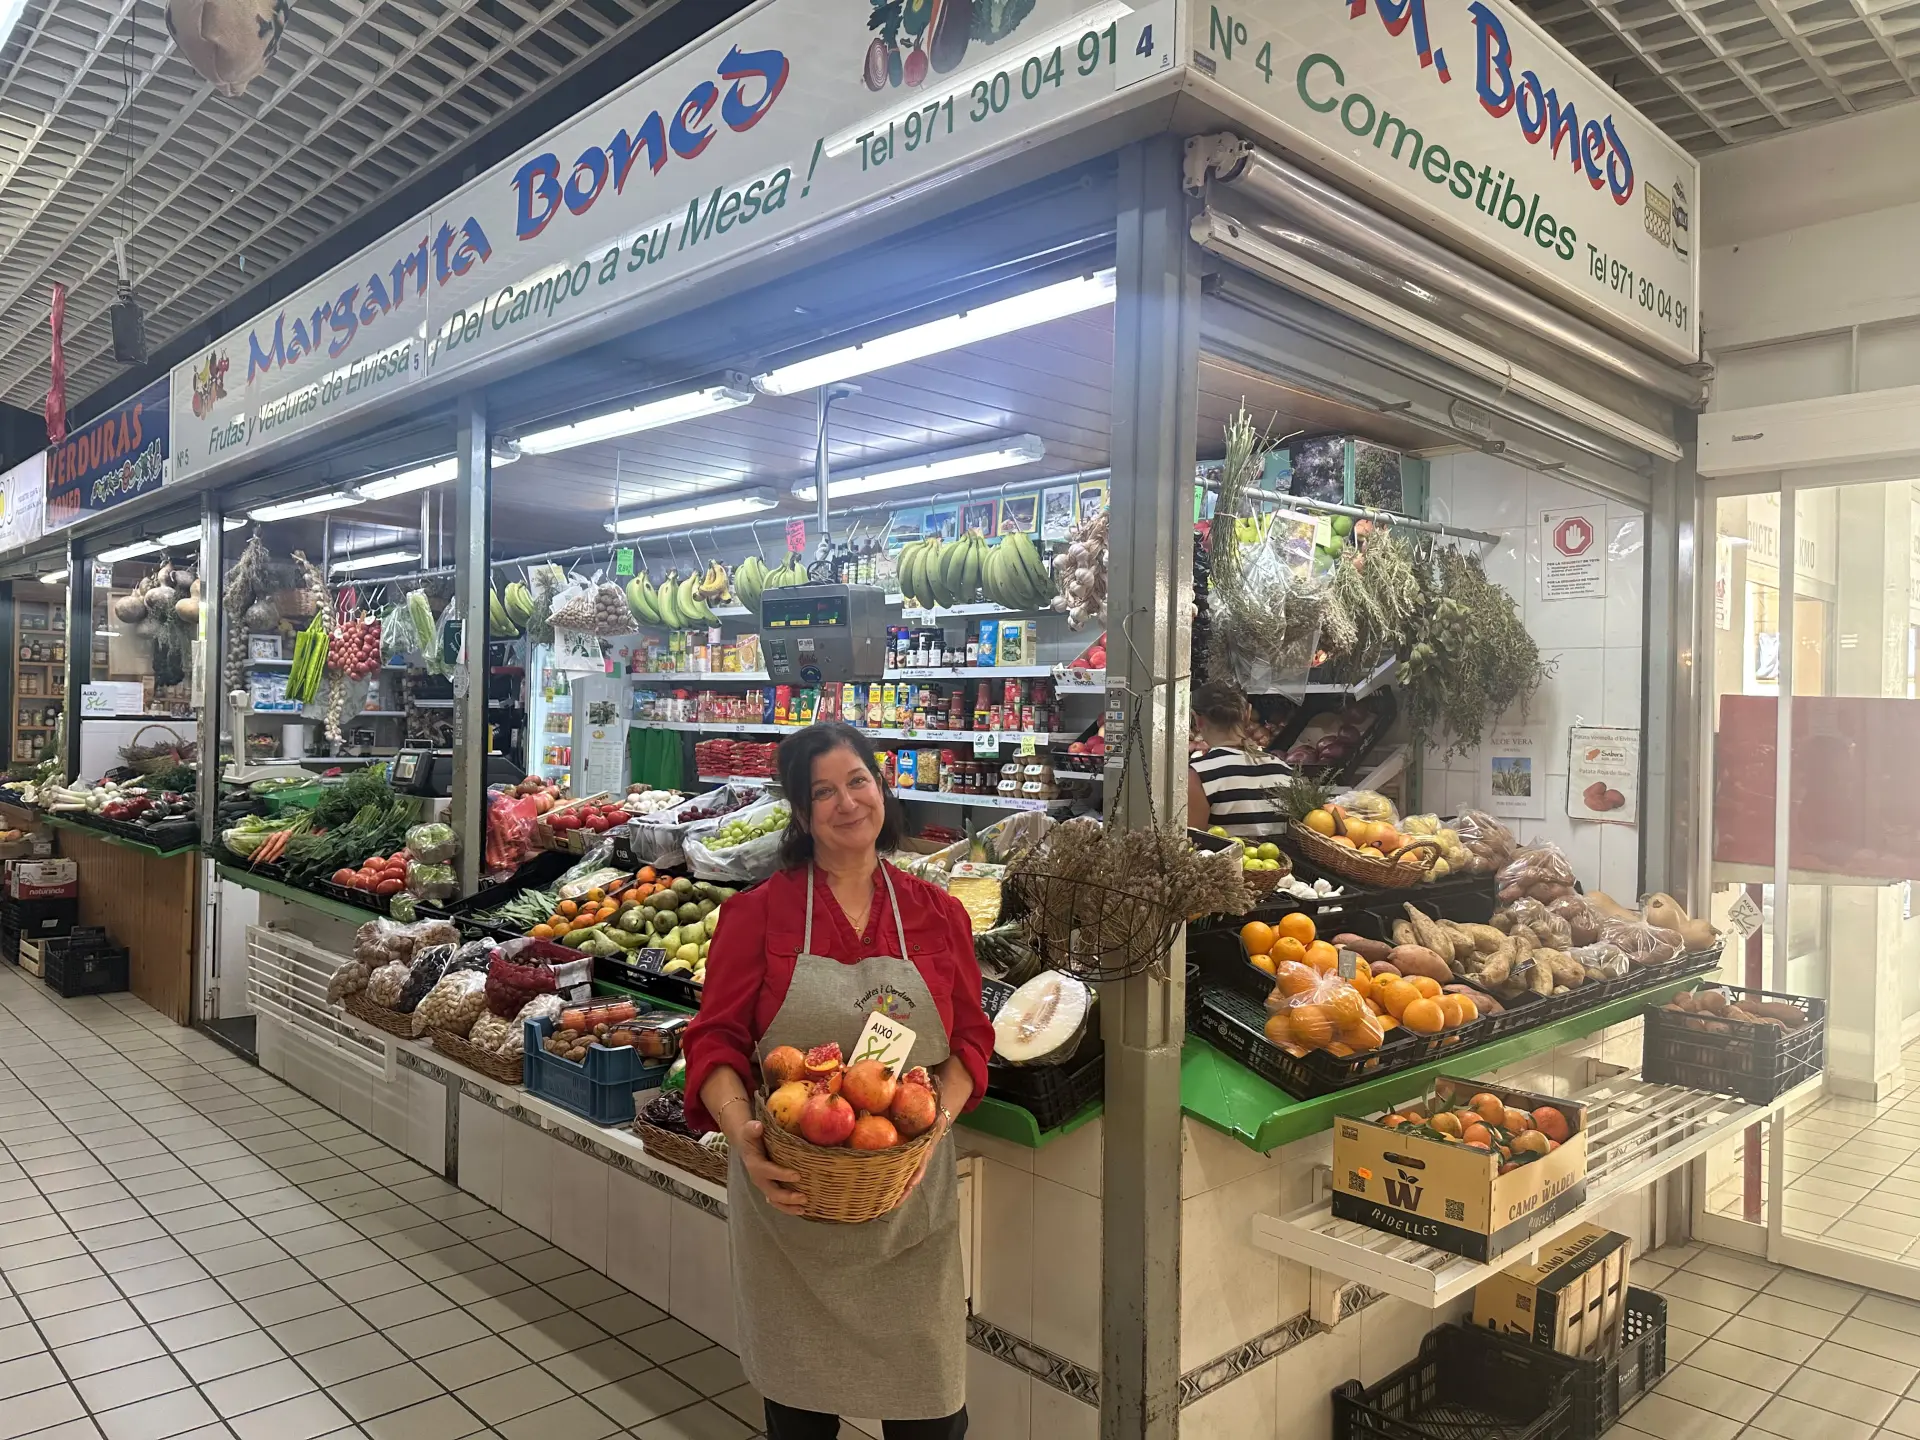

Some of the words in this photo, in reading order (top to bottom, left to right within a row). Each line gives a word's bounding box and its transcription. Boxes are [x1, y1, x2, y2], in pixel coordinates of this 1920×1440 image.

[1135, 24, 1154, 58] 4
[1255, 40, 1273, 84] 4
[856, 122, 894, 171] Tel
[904, 95, 954, 151] 971
[969, 72, 1010, 123] 30
[1021, 46, 1064, 100] 04
[1078, 21, 1116, 77] 91
[1467, 1, 1634, 205] Boned
[1296, 52, 1577, 261] Comestibles
[247, 214, 493, 387] Margarita
[509, 43, 790, 241] Boned
[446, 296, 487, 351] Del
[491, 259, 591, 331] Campo
[598, 253, 618, 286] a
[627, 222, 671, 272] su
[678, 166, 791, 251] Mesa
[1587, 242, 1606, 283] Tel
[1611, 259, 1633, 299] 971
[1639, 277, 1654, 311] 30
[1658, 289, 1671, 322] 04
[1675, 300, 1687, 332] 91
[413, 352, 420, 371] 5
[208, 420, 245, 455] Frutas
[246, 415, 256, 446] y
[259, 388, 318, 433] Verduras
[322, 377, 341, 406] de
[346, 345, 411, 395] Eivissa
[47, 403, 144, 489] VERDURAS
[184, 449, 189, 465] 5
[1371, 1207, 1439, 1236] RIBELLES
[1508, 1194, 1538, 1221] CAMP
[1542, 1171, 1576, 1203] WALDEN
[1528, 1203, 1557, 1228] RIBELLES
[1537, 1255, 1565, 1274] CAMP
[1561, 1233, 1599, 1257] WALDEN
